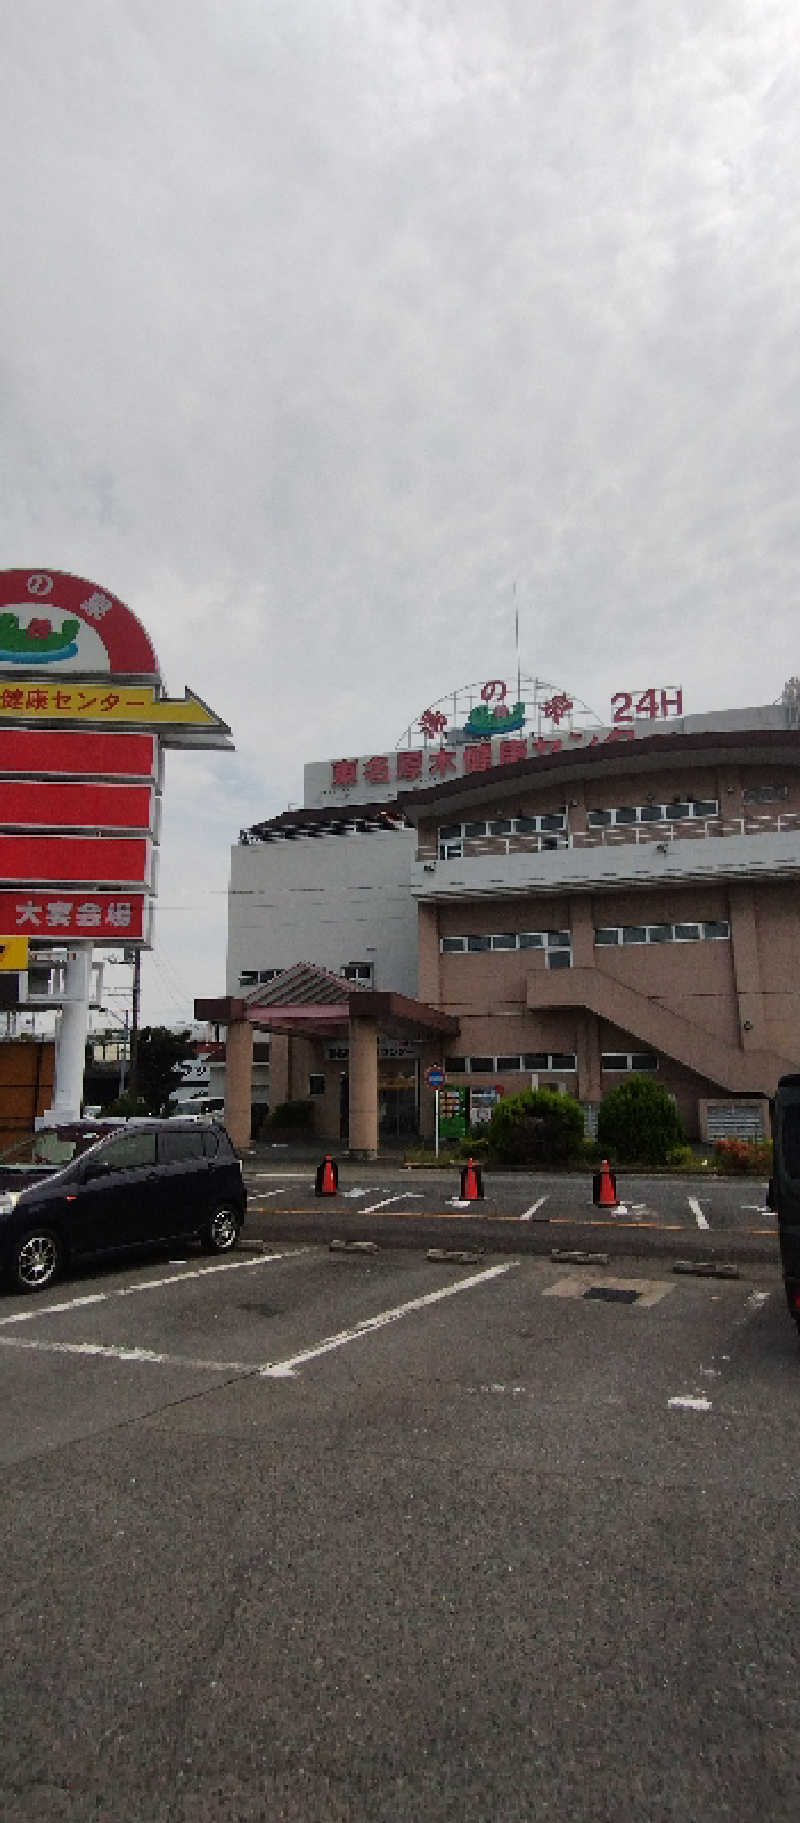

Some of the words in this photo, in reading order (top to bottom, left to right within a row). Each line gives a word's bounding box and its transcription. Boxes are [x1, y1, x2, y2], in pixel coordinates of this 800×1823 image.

[0, 688, 145, 712] 健康センター
[611, 688, 683, 722] 24H
